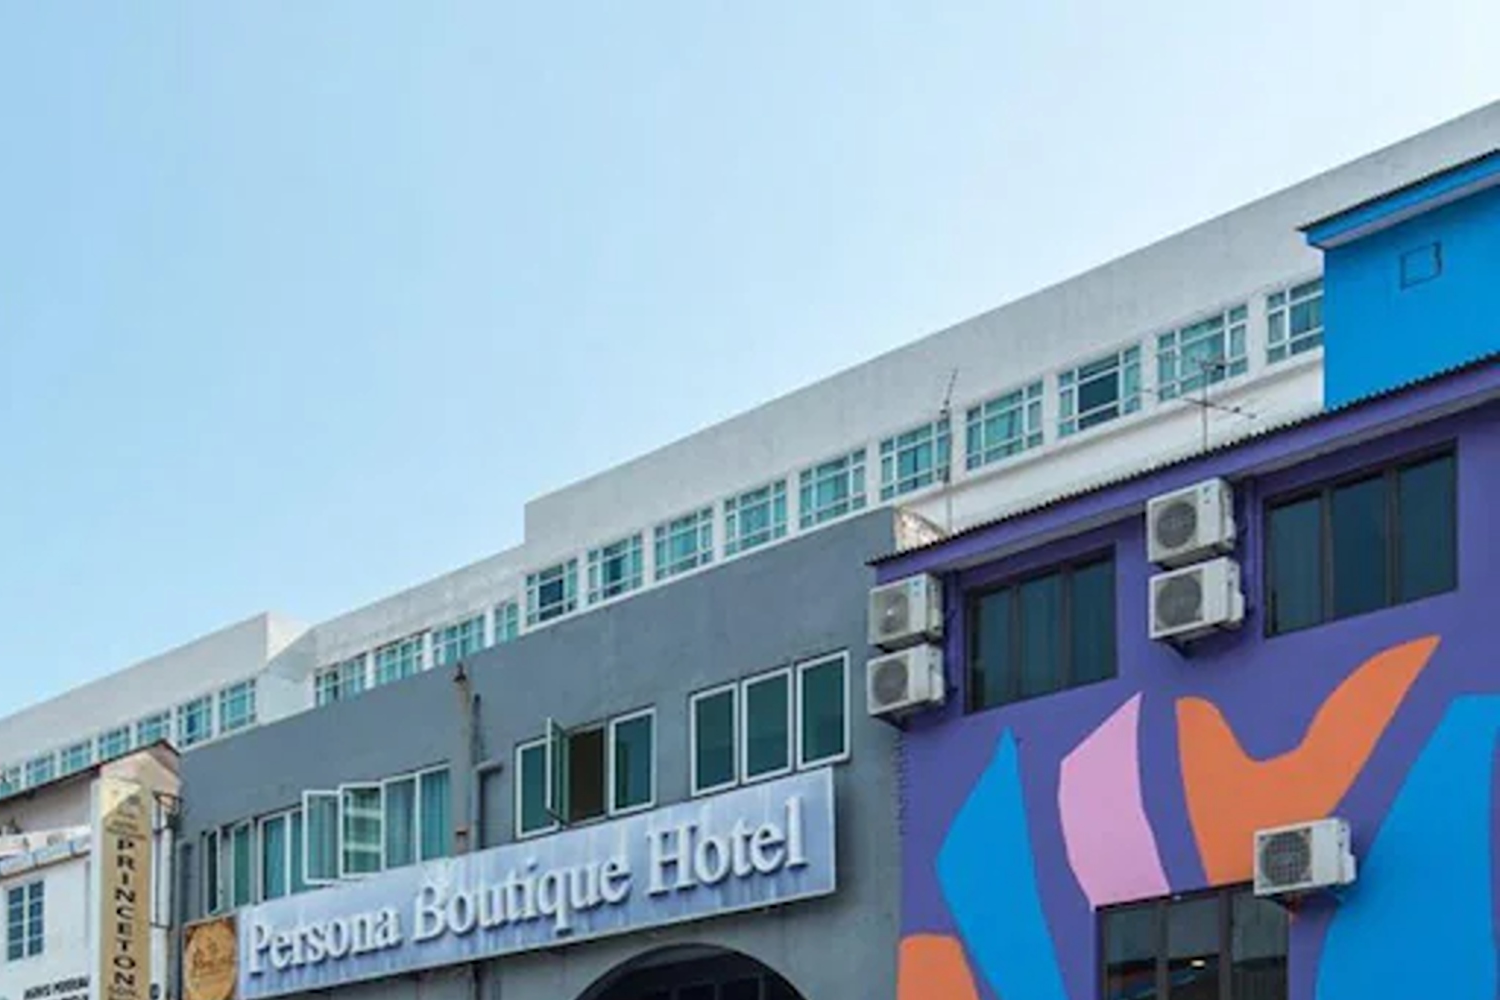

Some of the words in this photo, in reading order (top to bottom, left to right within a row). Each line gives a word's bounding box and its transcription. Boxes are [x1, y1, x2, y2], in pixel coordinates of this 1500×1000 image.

[112, 838, 137, 987] PRINCETON
[249, 906, 403, 975] Persona
[412, 854, 633, 935] Boutique
[647, 796, 809, 895] Hotel
